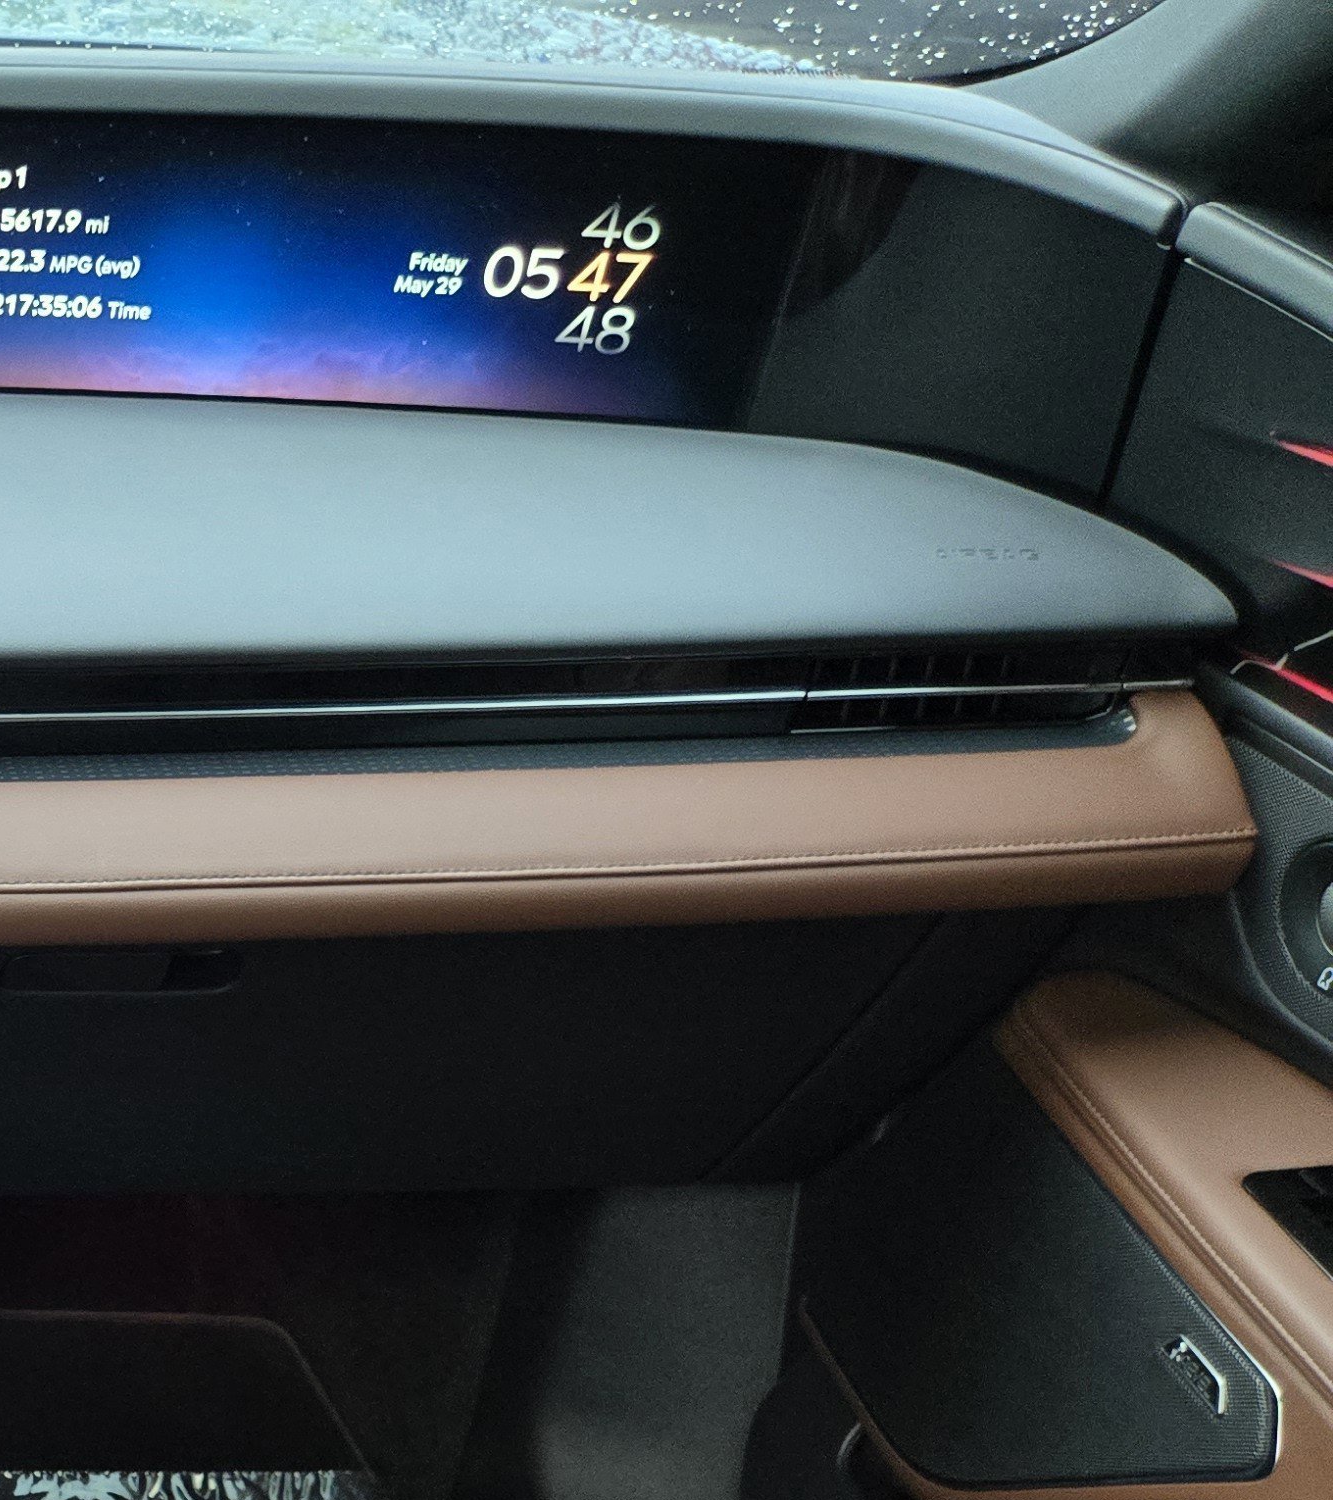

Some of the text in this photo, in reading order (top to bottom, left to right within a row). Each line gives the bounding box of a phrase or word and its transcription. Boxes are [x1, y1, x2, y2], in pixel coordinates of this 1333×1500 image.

[15, 165, 28, 189] 1
[0, 207, 111, 234] 5617.9 mi
[580, 202, 661, 251] 46
[49, 255, 93, 275] MPG
[94, 254, 141, 280] (avg)
[408, 251, 470, 276] Friday
[483, 246, 656, 304] 05 47
[393, 275, 463, 298] May 29
[107, 300, 152, 321] Time
[554, 306, 636, 355] 48
